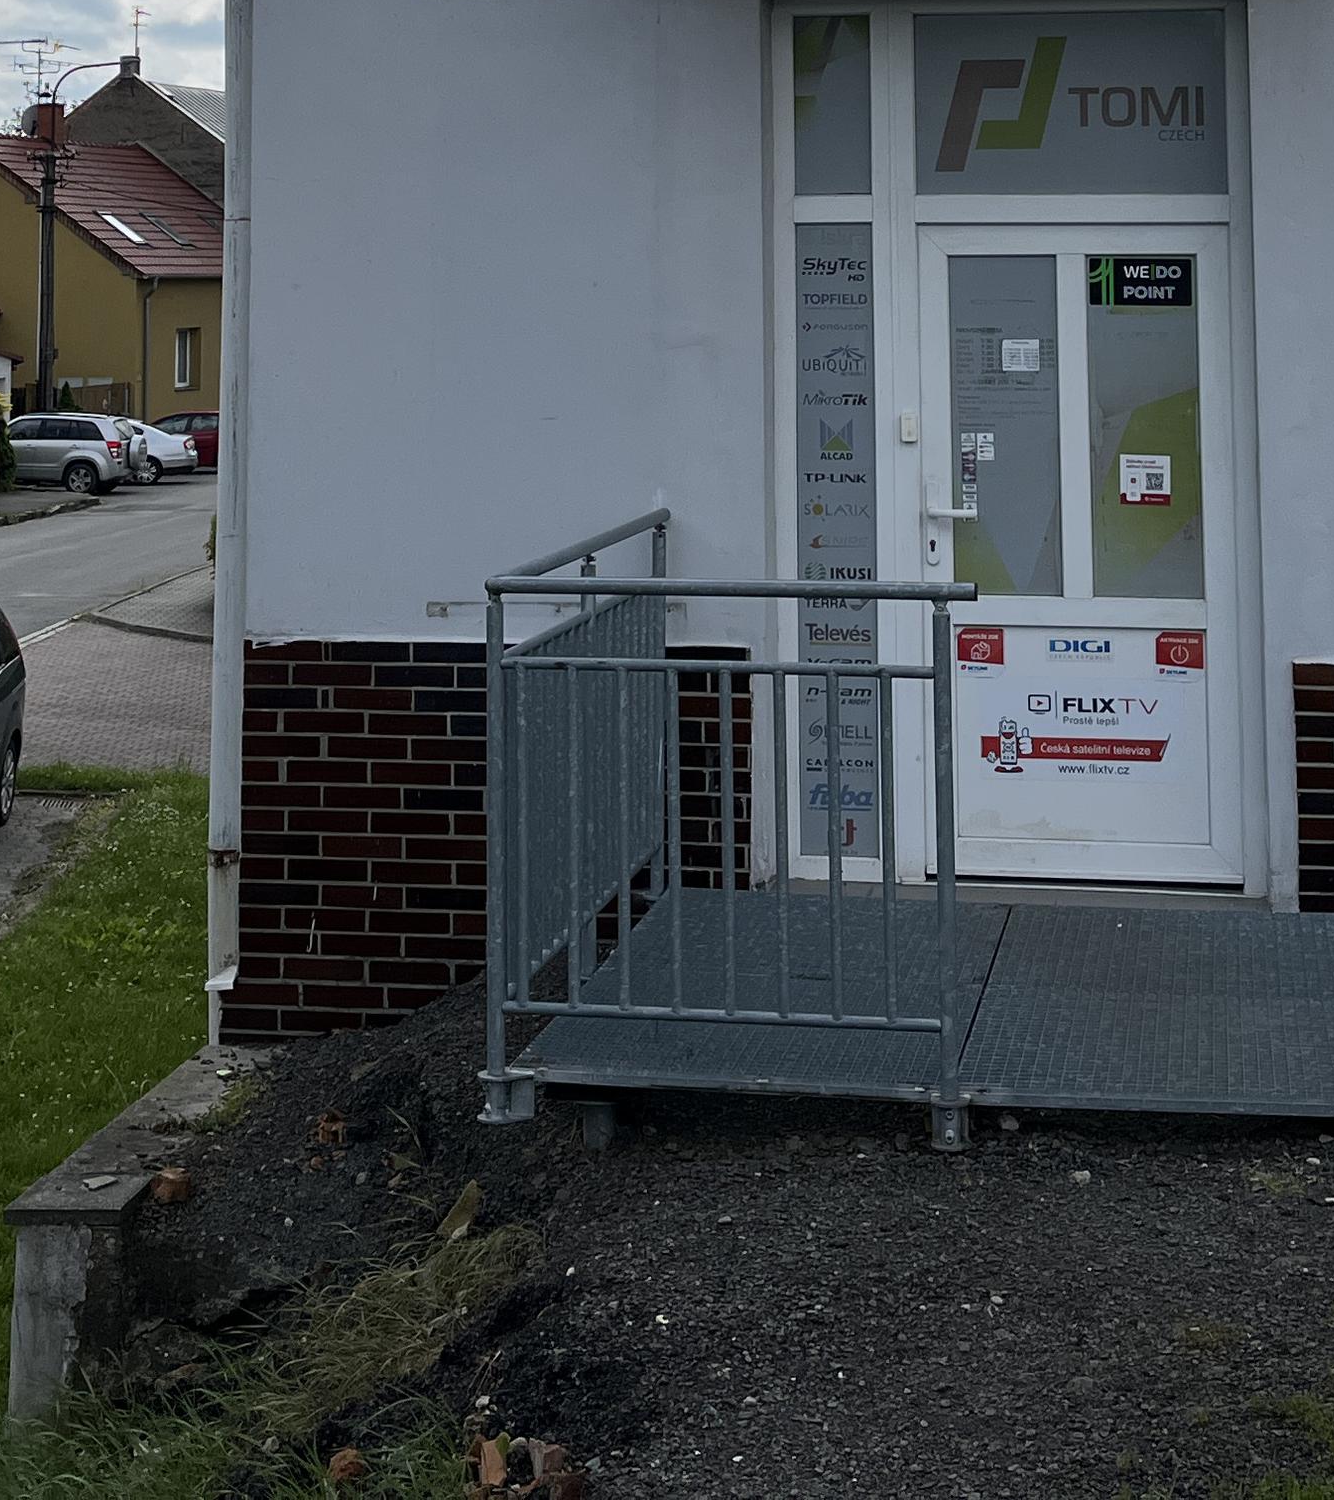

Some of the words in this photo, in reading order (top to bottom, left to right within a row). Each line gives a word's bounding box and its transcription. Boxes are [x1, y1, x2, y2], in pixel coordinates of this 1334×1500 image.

[1068, 86, 1205, 127] TOMI
[1158, 130, 1205, 141] CZECH
[1123, 286, 1176, 299] POINT
[802, 293, 868, 305] TOPFIELD
[820, 452, 853, 461] ALCAD
[803, 473, 867, 484] TP-LINK
[830, 567, 872, 580] IKUSI
[804, 596, 848, 609] TERRA
[804, 623, 872, 642] Televés
[1049, 639, 1111, 653] DIGI
[807, 687, 872, 697] n-am
[1063, 716, 1094, 725] Prostě
[1096, 716, 1120, 726] lepší
[1040, 742, 1071, 754] Česká
[1072, 743, 1112, 755] satelitní
[1113, 745, 1152, 756] televize
[1058, 764, 1130, 775] www.flixtv.cz
